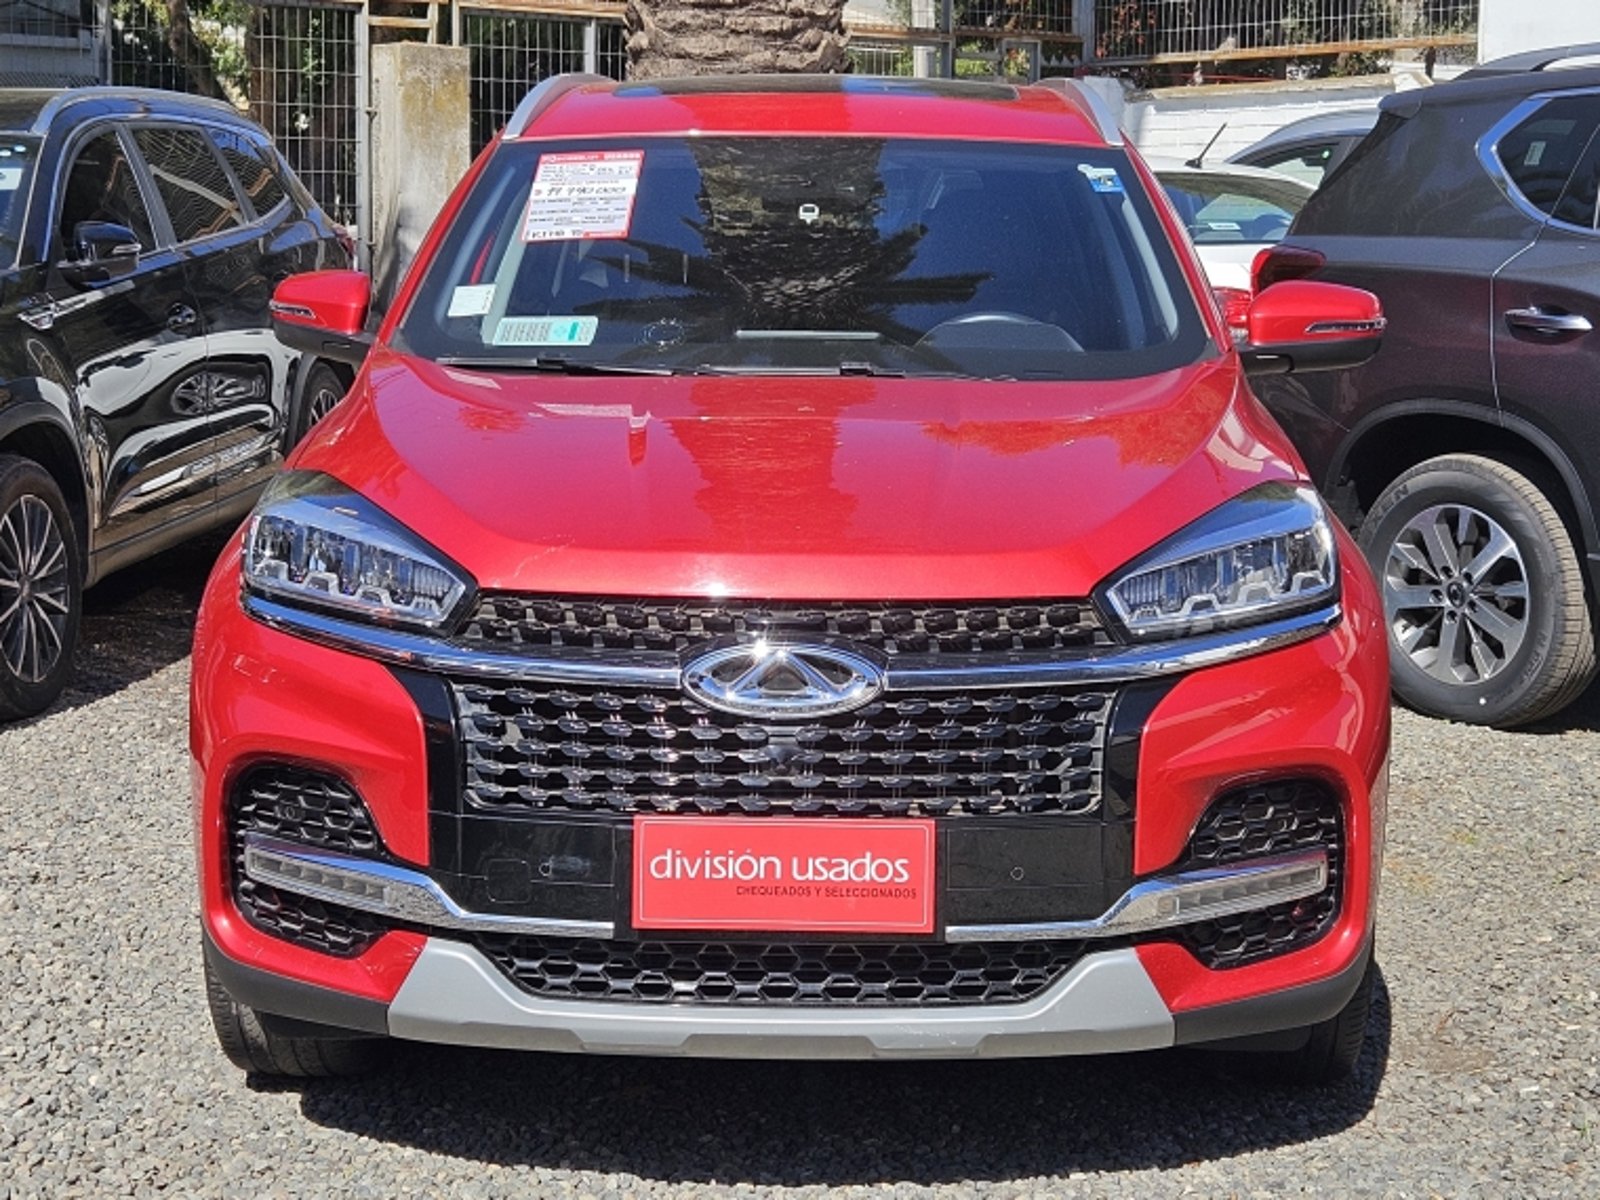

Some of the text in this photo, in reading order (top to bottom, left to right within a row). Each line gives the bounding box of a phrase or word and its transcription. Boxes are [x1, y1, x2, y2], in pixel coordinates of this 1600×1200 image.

[649, 848, 910, 884] división usados
[736, 885, 917, 899] CHEQUEADOS Y SELECCIONADOS
